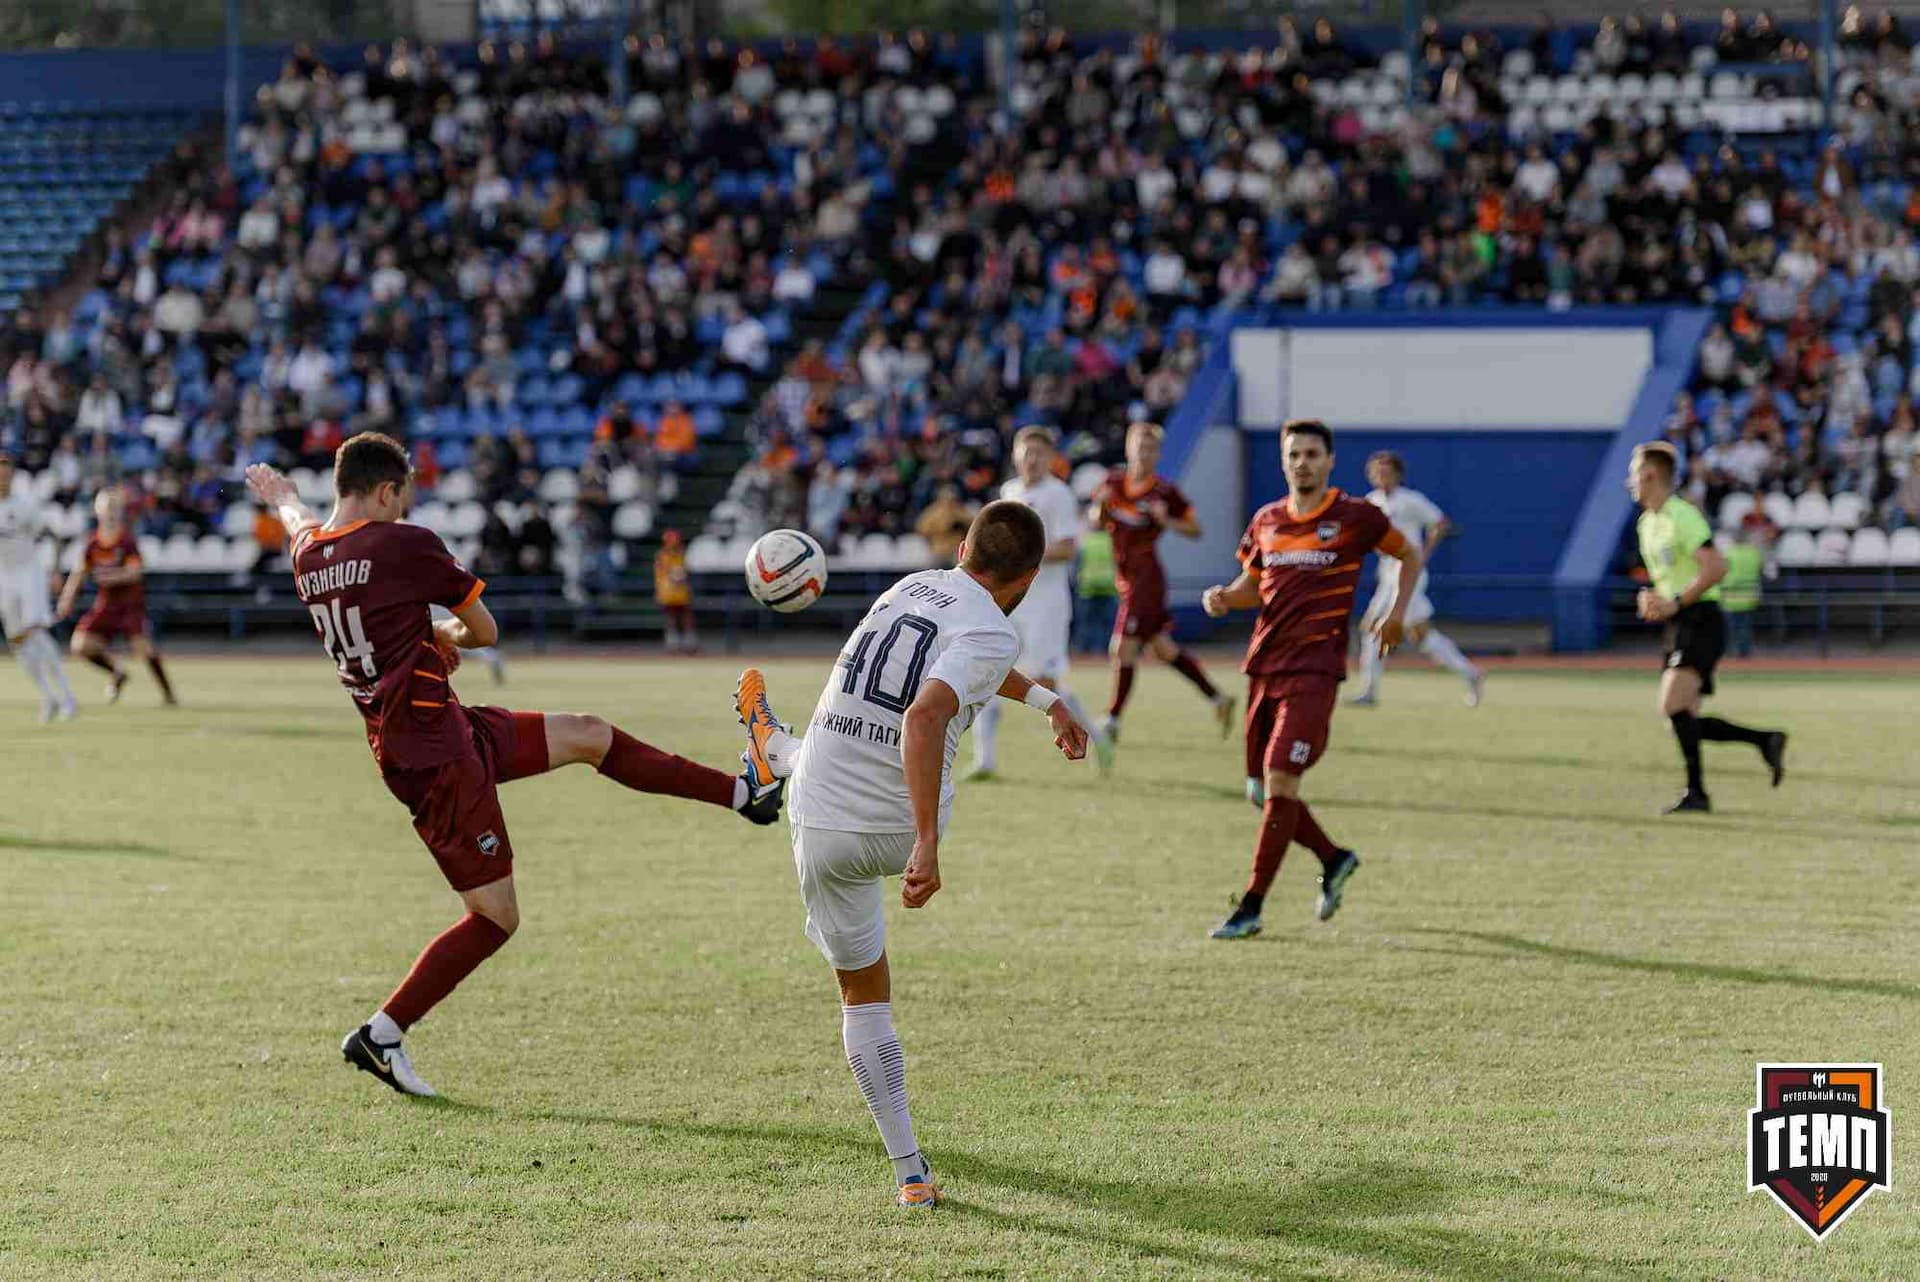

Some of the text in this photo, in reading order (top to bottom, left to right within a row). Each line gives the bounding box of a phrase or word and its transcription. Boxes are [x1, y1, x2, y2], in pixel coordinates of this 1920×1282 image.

[900, 582, 958, 609] ГОРИН
[309, 598, 377, 678] 24
[840, 613, 938, 714] 40
[815, 711, 902, 746] ЖНИЙ ТАГИ
